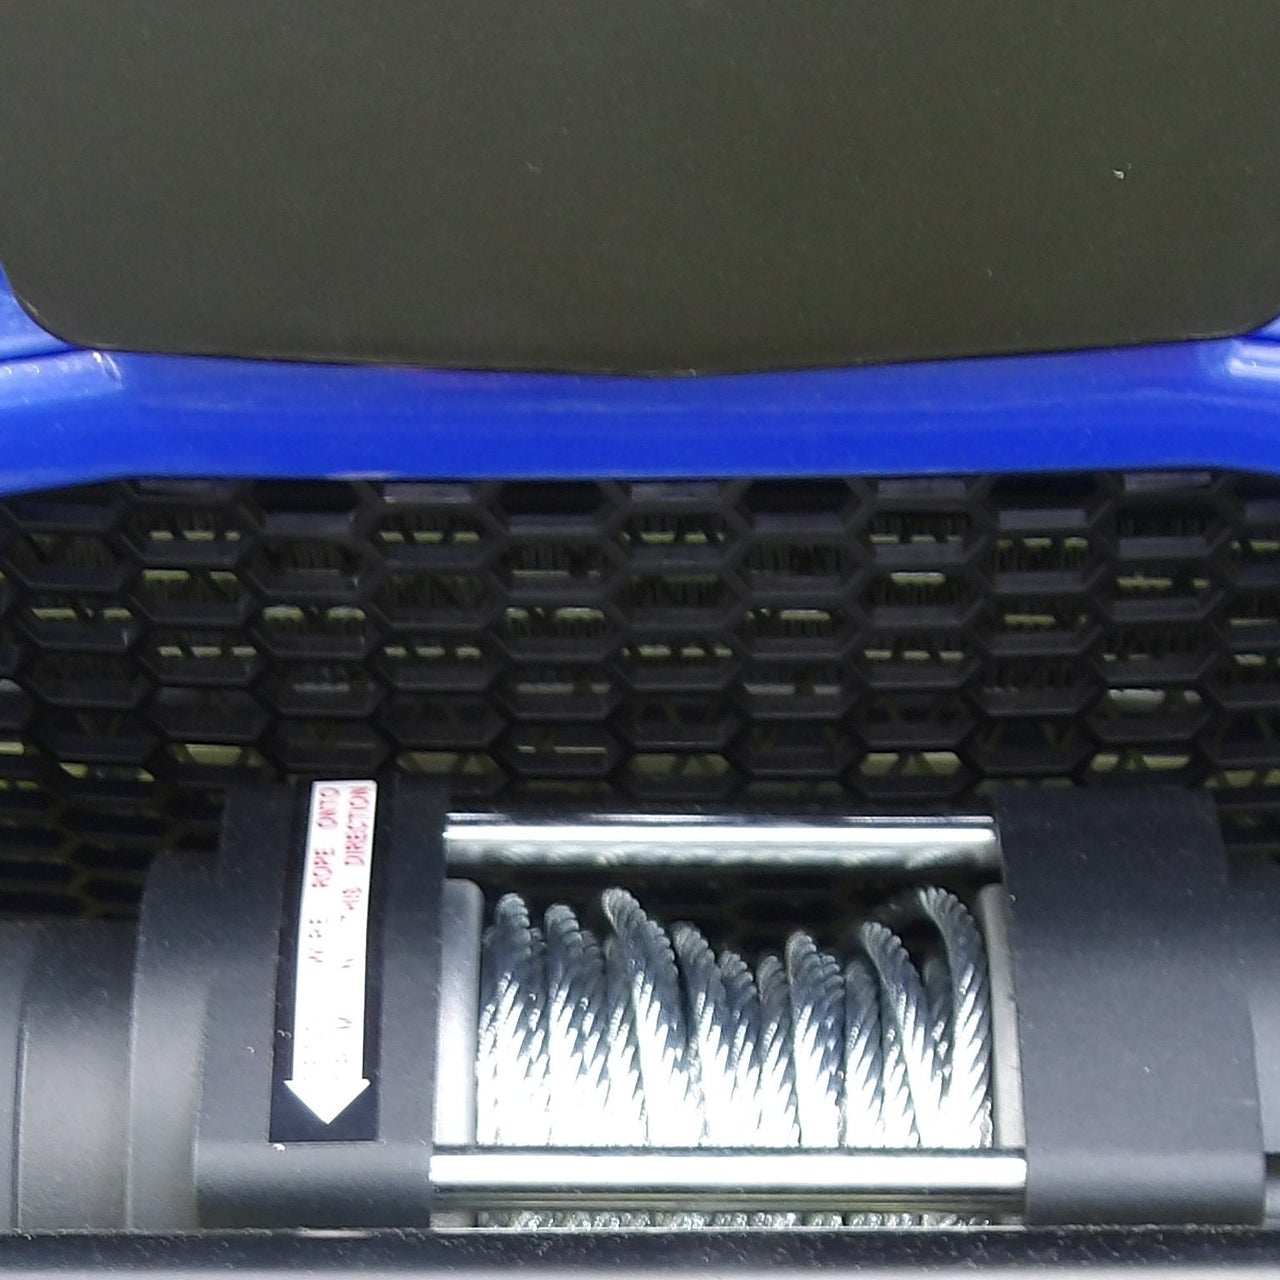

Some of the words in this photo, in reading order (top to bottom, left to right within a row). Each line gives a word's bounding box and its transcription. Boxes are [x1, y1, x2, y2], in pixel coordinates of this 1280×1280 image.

[317, 786, 341, 830] ONTO
[344, 785, 369, 866] DIRECTION
[312, 848, 336, 888] ROPE
